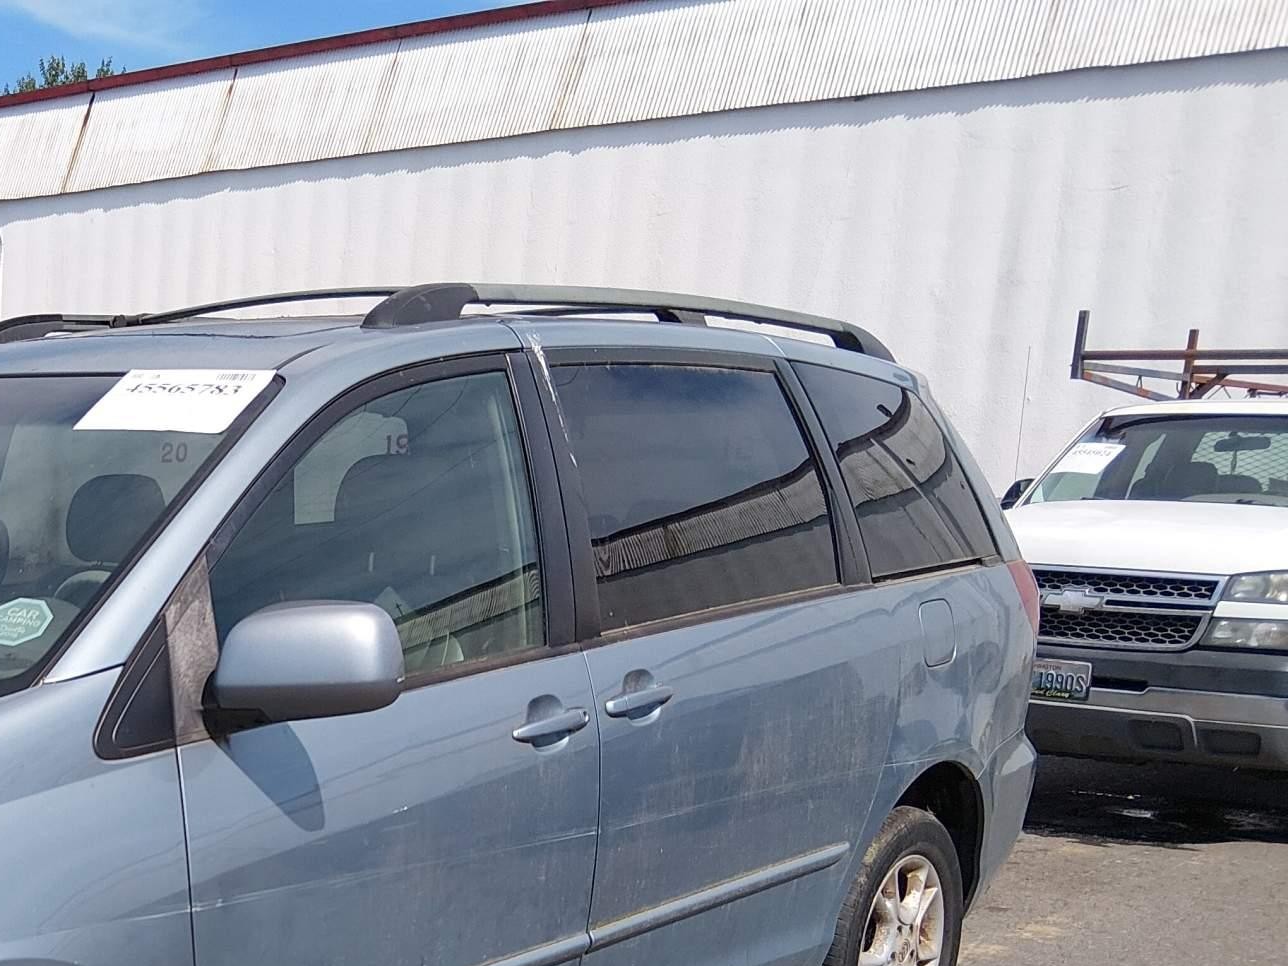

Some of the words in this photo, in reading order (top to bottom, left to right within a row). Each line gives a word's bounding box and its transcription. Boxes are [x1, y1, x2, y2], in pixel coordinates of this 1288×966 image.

[126, 383, 243, 395] 45565783
[161, 442, 188, 463] 20
[8, 607, 39, 620] CAR
[1033, 671, 1085, 693] 1990S
